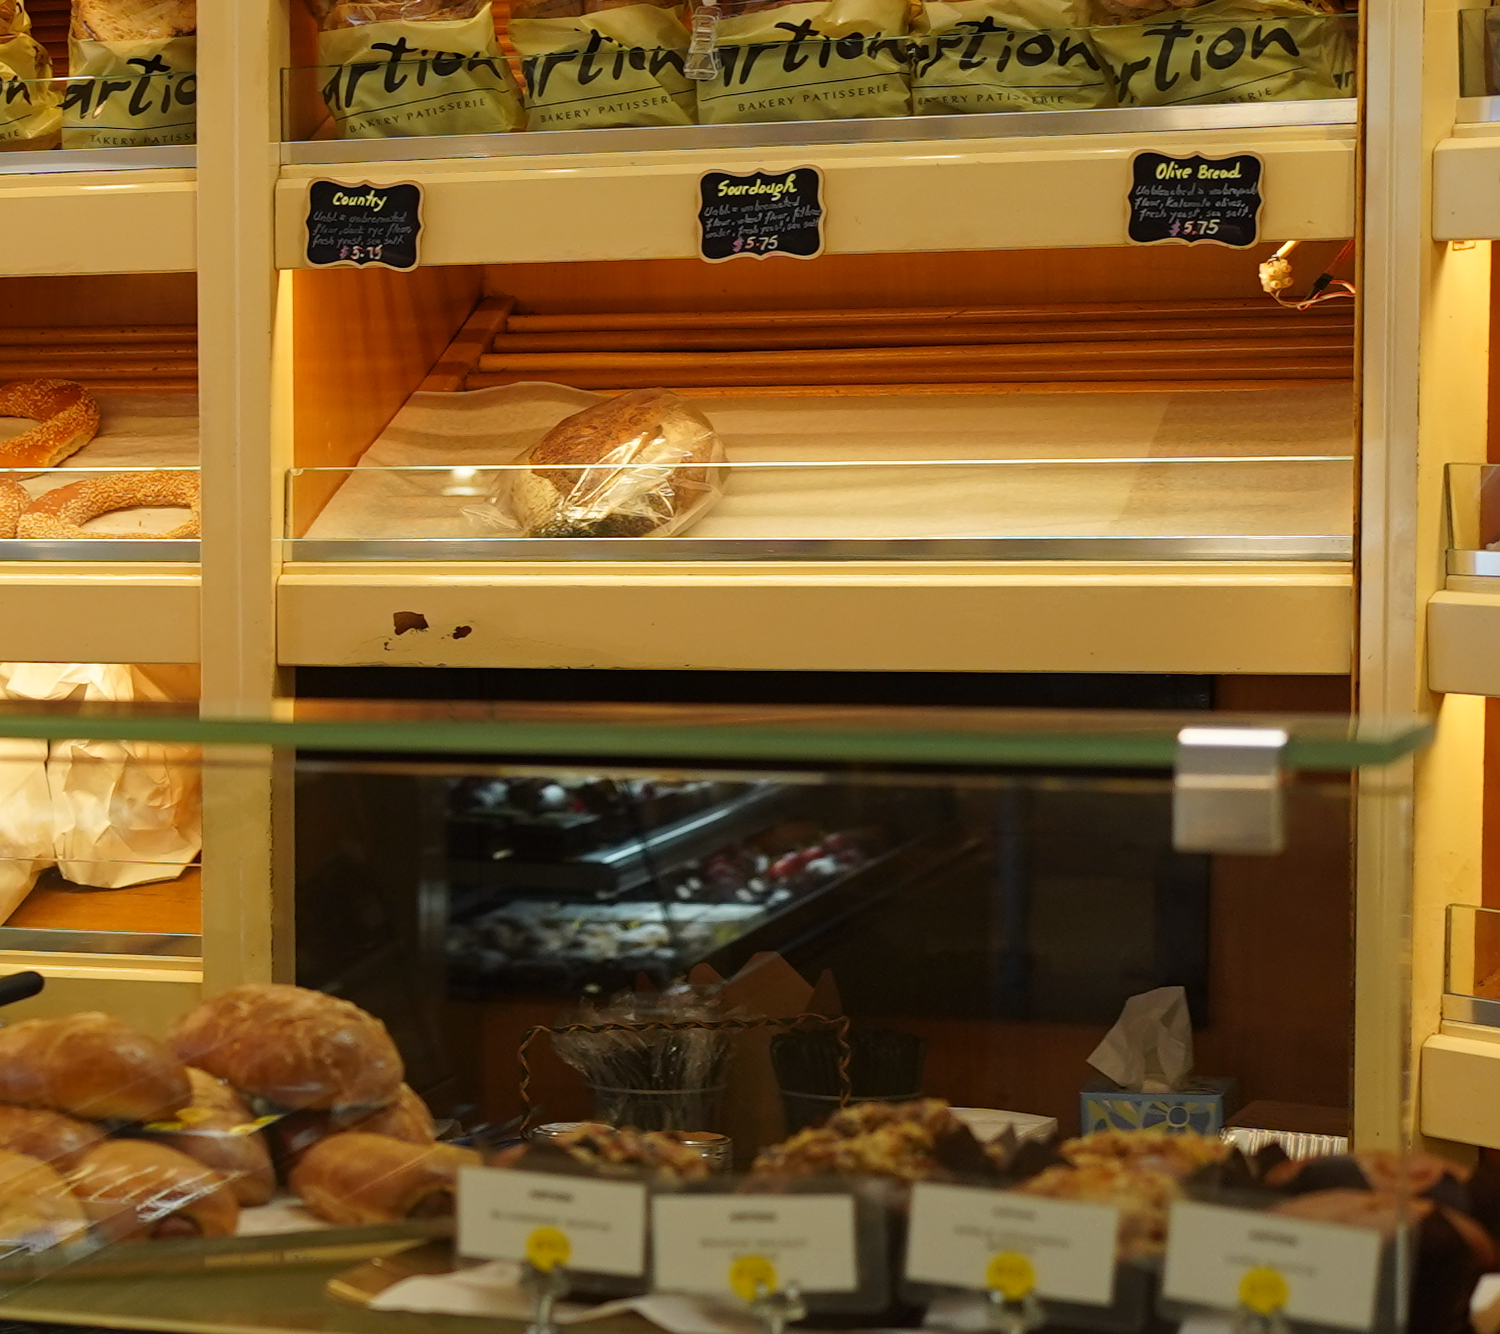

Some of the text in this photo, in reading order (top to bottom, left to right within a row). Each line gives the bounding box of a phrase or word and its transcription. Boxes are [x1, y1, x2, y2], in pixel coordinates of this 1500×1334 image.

[1112, 20, 1300, 104] rtion
[57, 54, 197, 119] artio
[738, 83, 890, 112] BAKERY PATISSERIE
[349, 98, 486, 133] BAKERY PATISSERIE
[540, 94, 669, 123] BAKERY PATISSER
[144, 133, 191, 144] PATISS
[1156, 161, 1242, 179] Olive Bread
[718, 173, 797, 201] Sourdough
[332, 190, 387, 212] Country
[1139, 208, 1167, 222] fresh
[368, 228, 384, 237] rye
[1169, 219, 1220, 237] $5.75
[733, 235, 778, 253] $5.75
